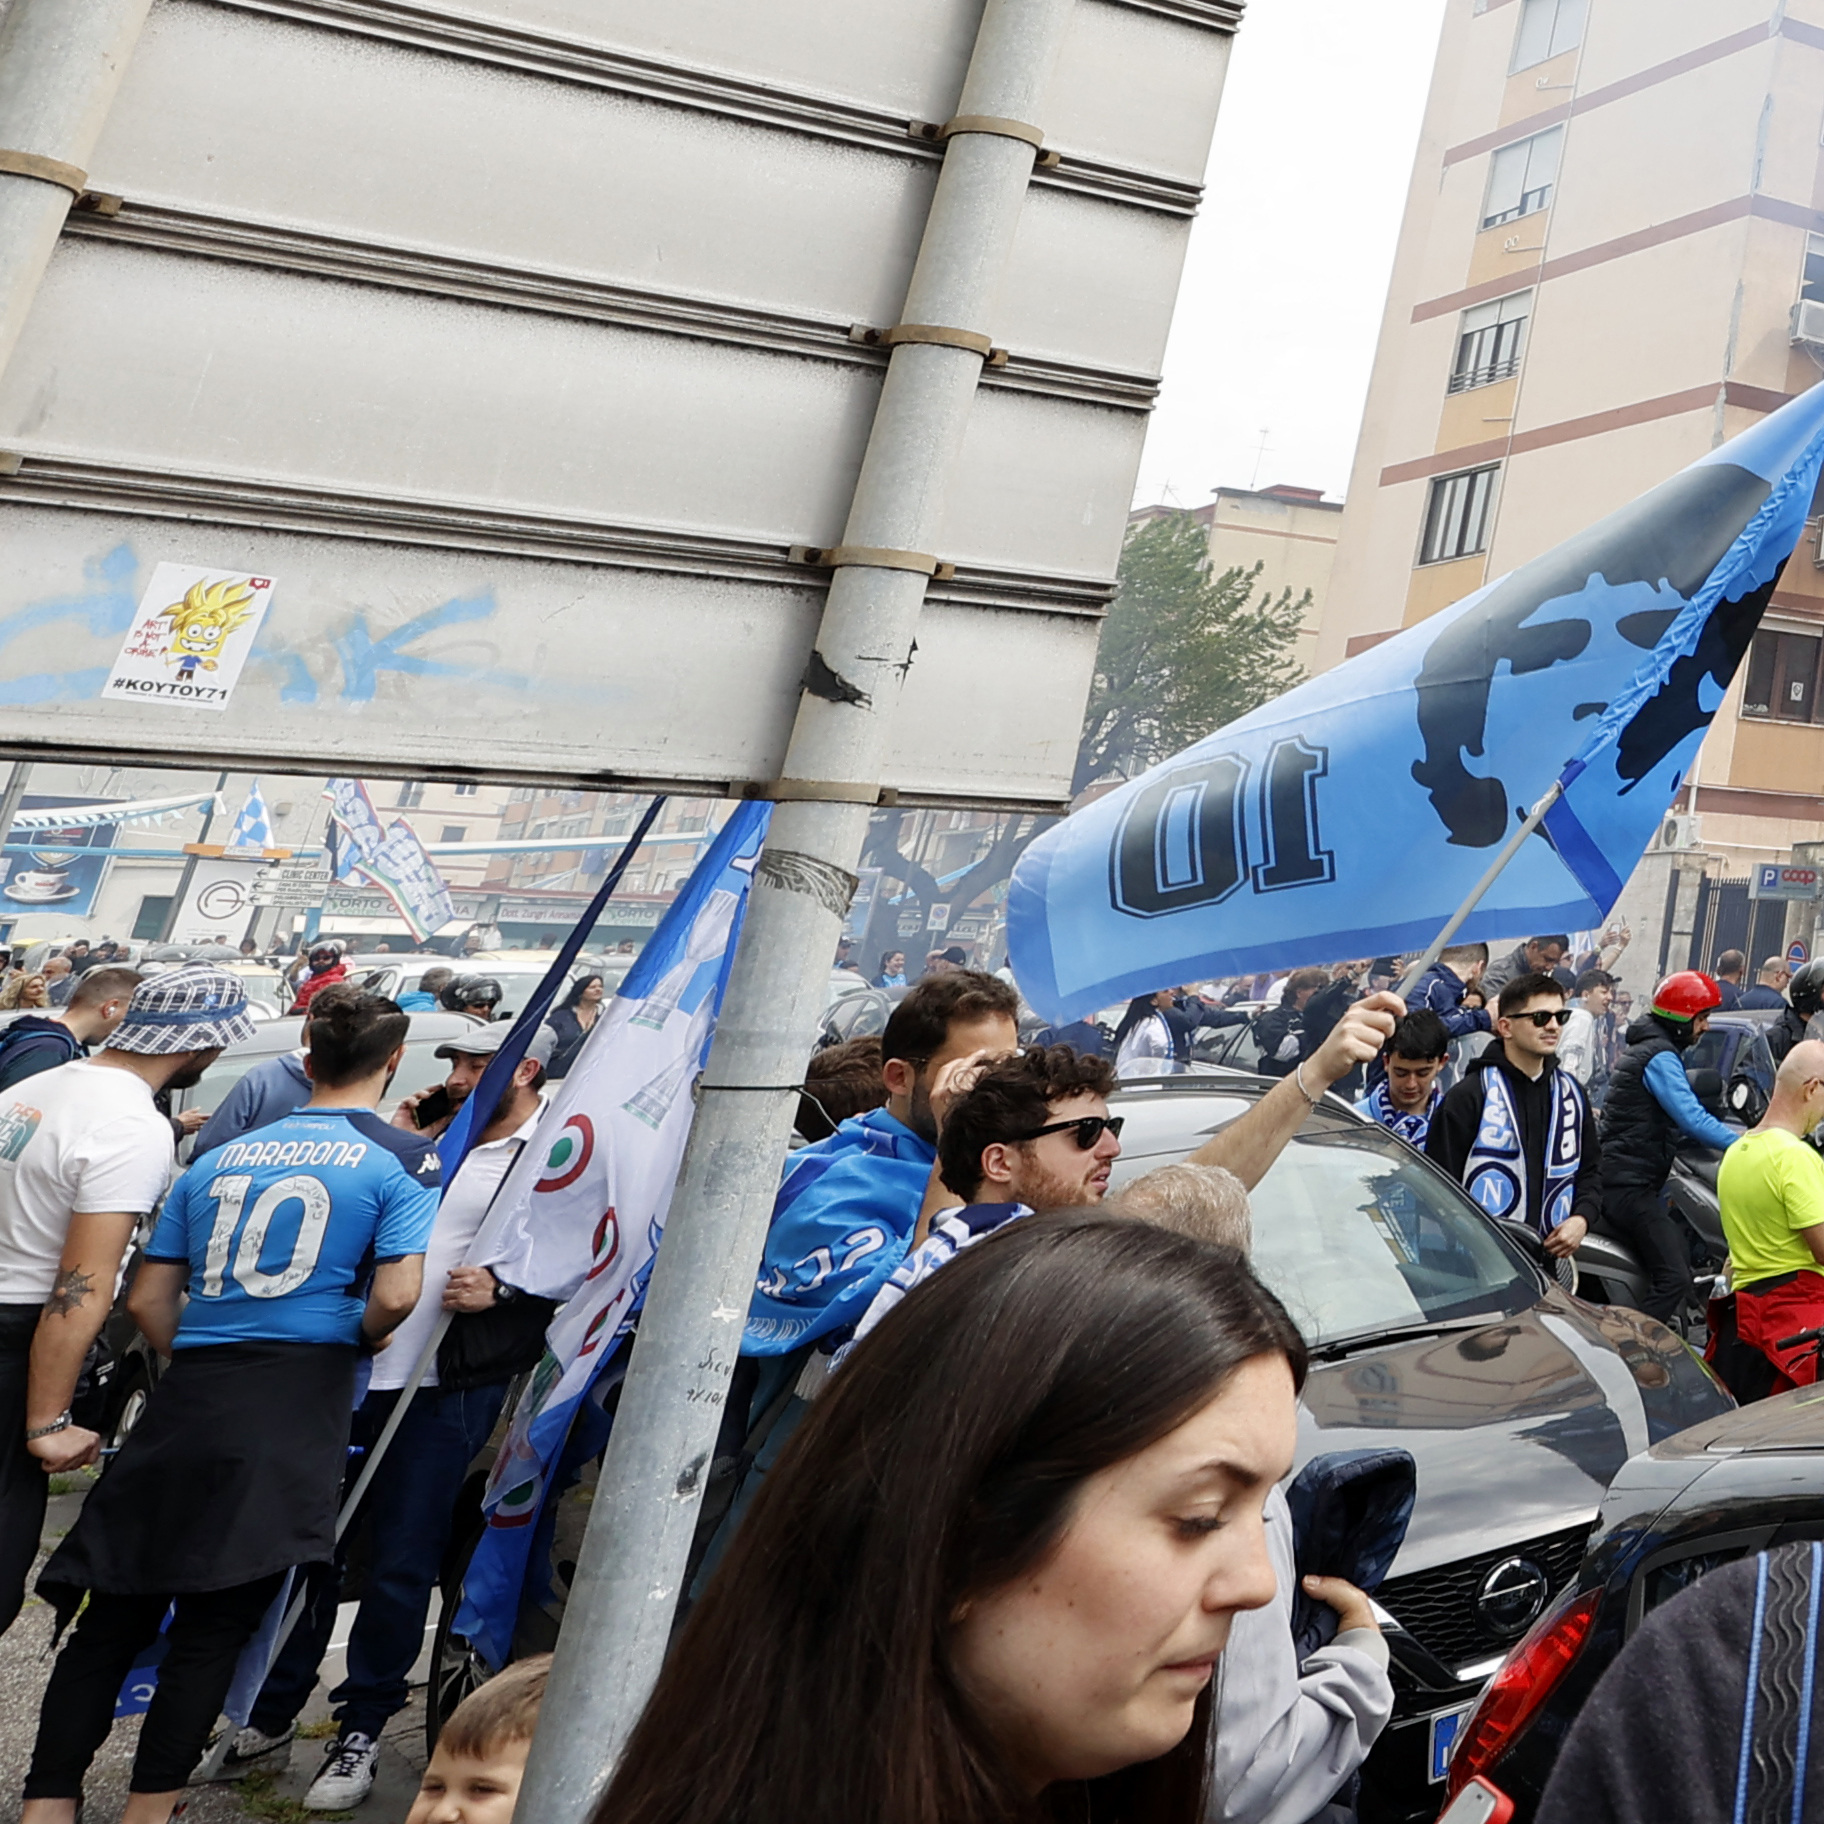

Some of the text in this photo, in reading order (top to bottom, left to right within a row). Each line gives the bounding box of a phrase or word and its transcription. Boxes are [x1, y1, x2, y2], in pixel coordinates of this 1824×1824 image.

[112, 677, 229, 700] #KOYTOY71
[1781, 869, 1818, 886] coop
[339, 898, 382, 910] ORTO
[616, 907, 656, 919] ORTO
[214, 1140, 369, 1170] MARADONA
[200, 1173, 333, 1299] 10
